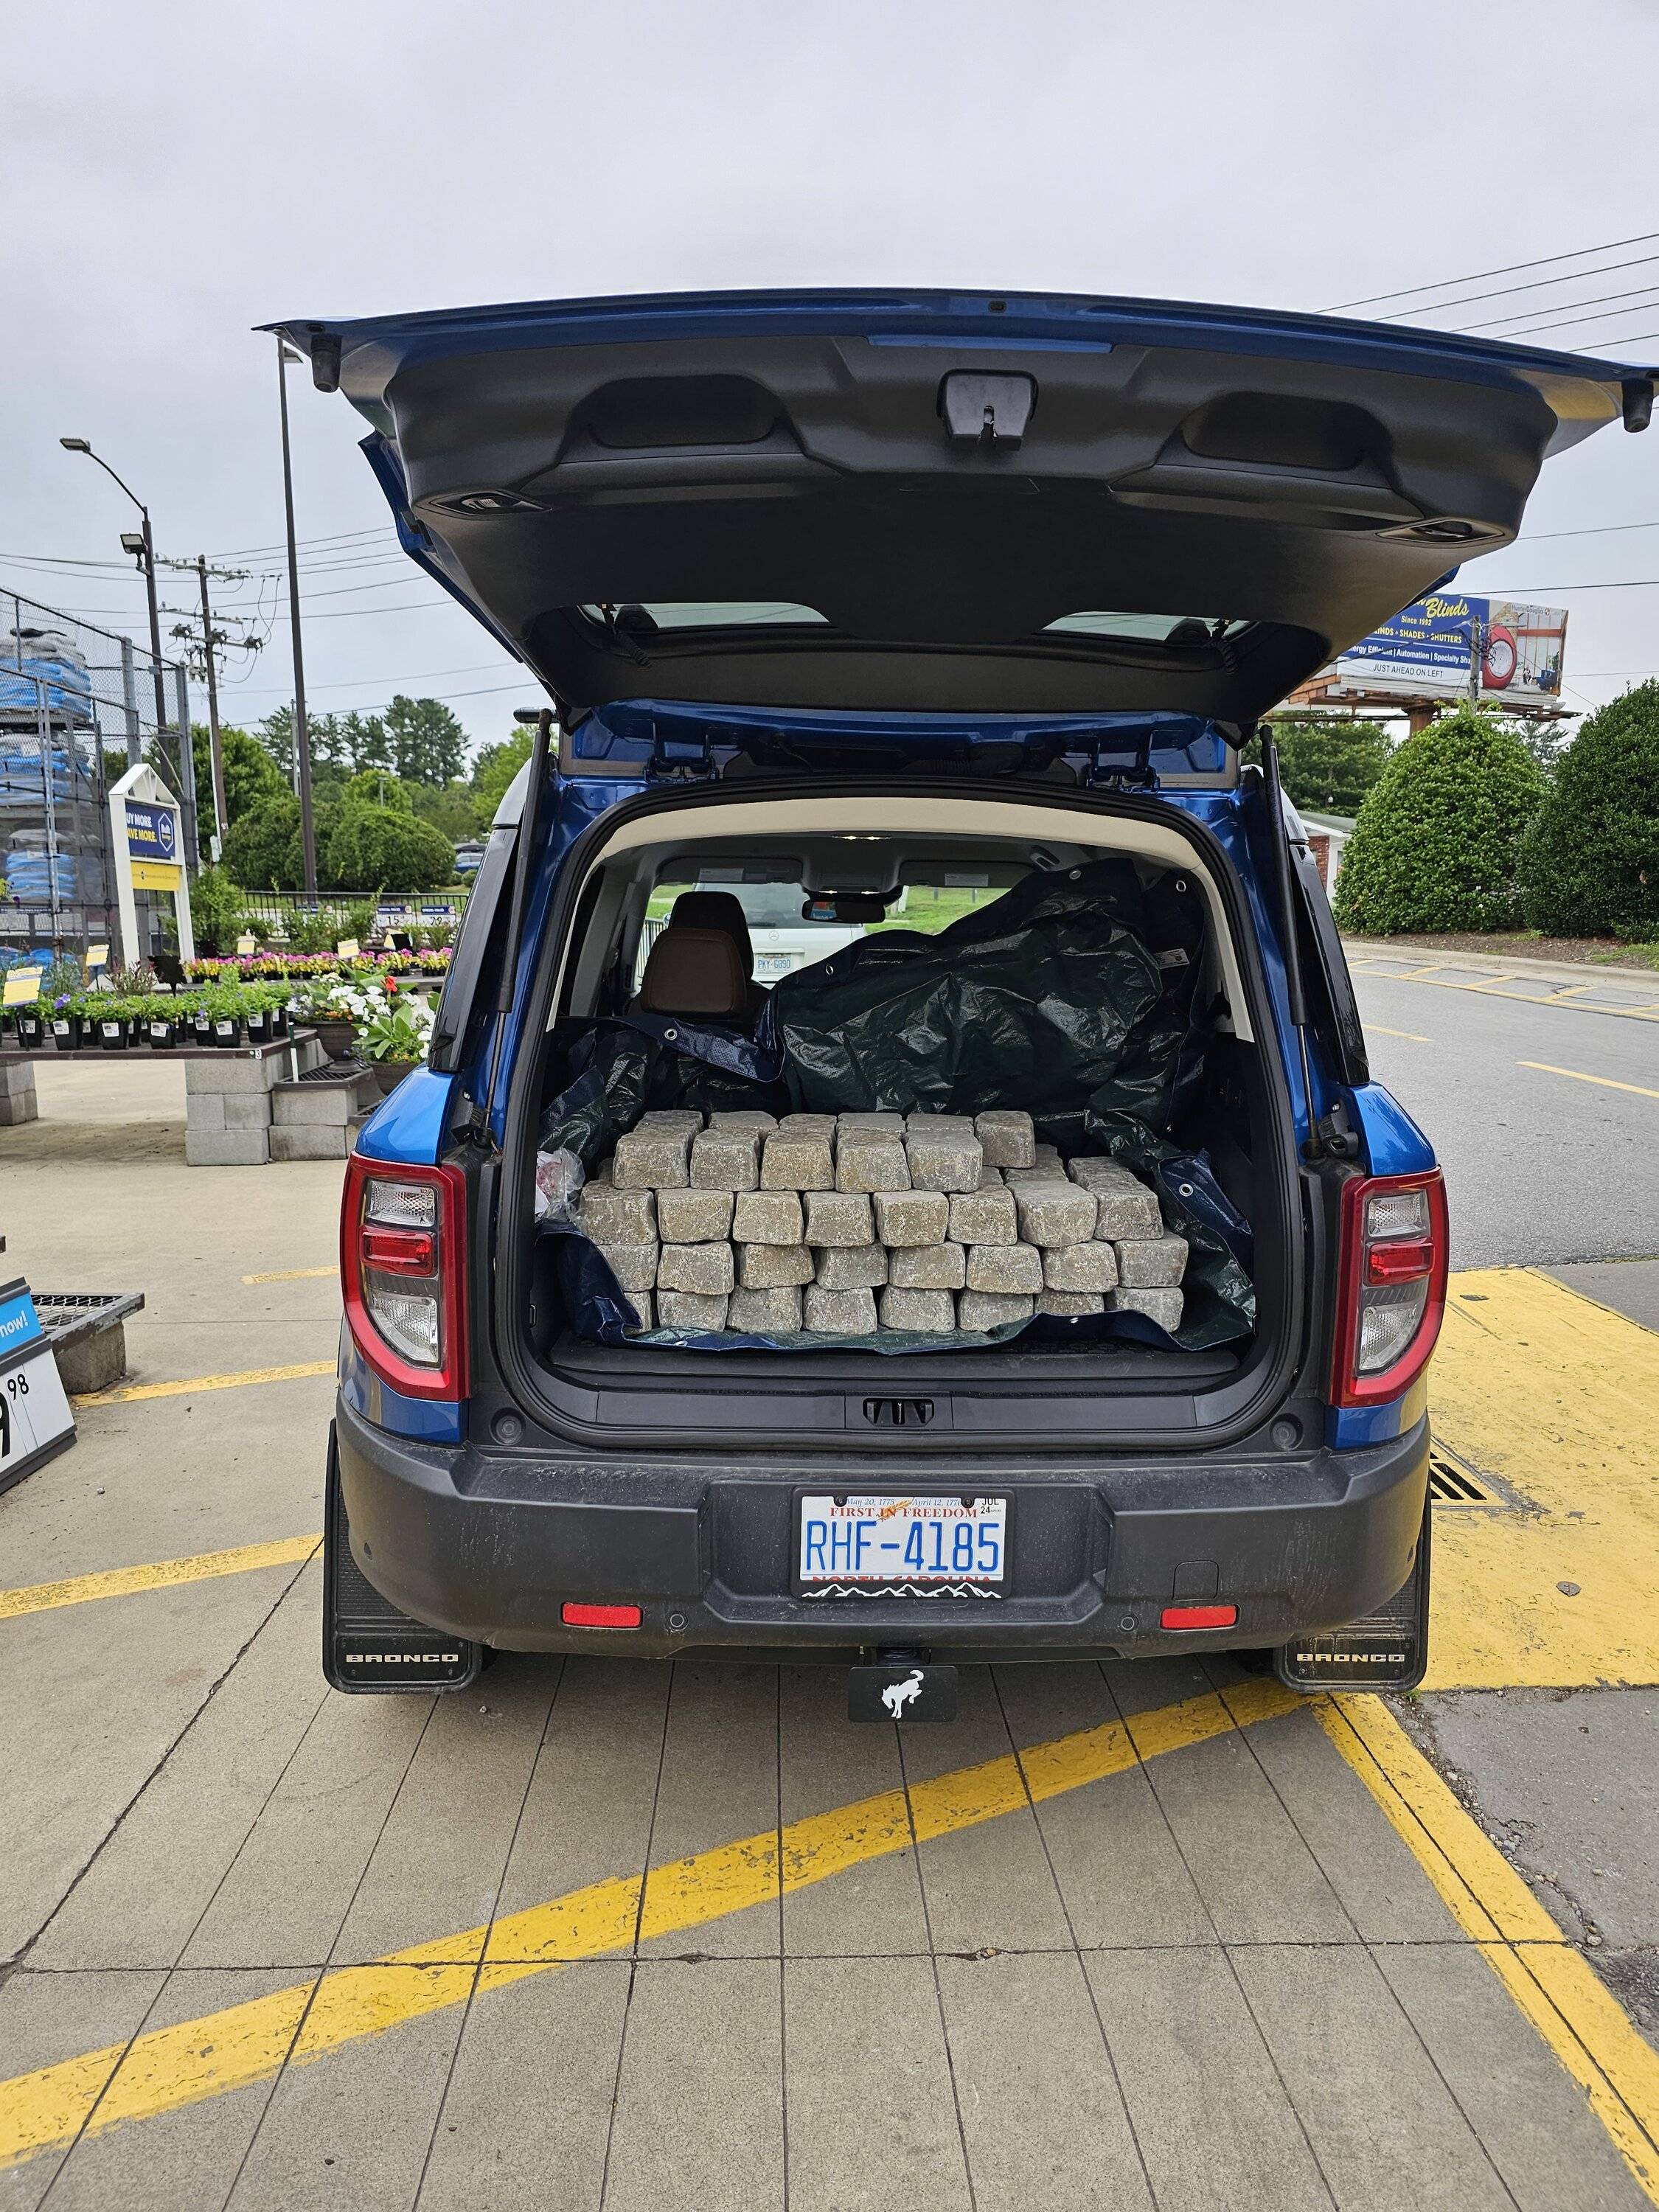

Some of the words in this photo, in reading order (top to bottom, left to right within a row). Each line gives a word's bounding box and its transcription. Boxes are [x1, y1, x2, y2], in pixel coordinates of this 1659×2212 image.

[1426, 597, 1469, 618] Blinds
[1402, 616, 1417, 624] Since
[1419, 618, 1432, 626] 1992
[1374, 627, 1394, 636] INDS
[1399, 629, 1425, 639] SHADES
[1431, 633, 1462, 644] SHUTTERS
[1397, 649, 1433, 660] Automation
[1433, 653, 1460, 664] Specialty
[1374, 664, 1390, 672] JUST
[1391, 666, 1414, 675] AHEAD
[1416, 668, 1426, 676] ON
[1427, 669, 1444, 678] LEFT
[126, 812, 134, 824] UY
[135, 813, 152, 827] MORE
[128, 827, 139, 839] AVE
[846, 1498, 863, 1507] May
[864, 1498, 876, 1506] 20,
[912, 1498, 932, 1507] April
[830, 1507, 874, 1517] FIRST
[880, 1508, 897, 1517] IN
[903, 1508, 977, 1517] FREEDOM
[807, 1520, 1000, 1571] RHF-4185
[346, 1654, 459, 1663] BRONCO
[1297, 1653, 1405, 1662] BRONCO
